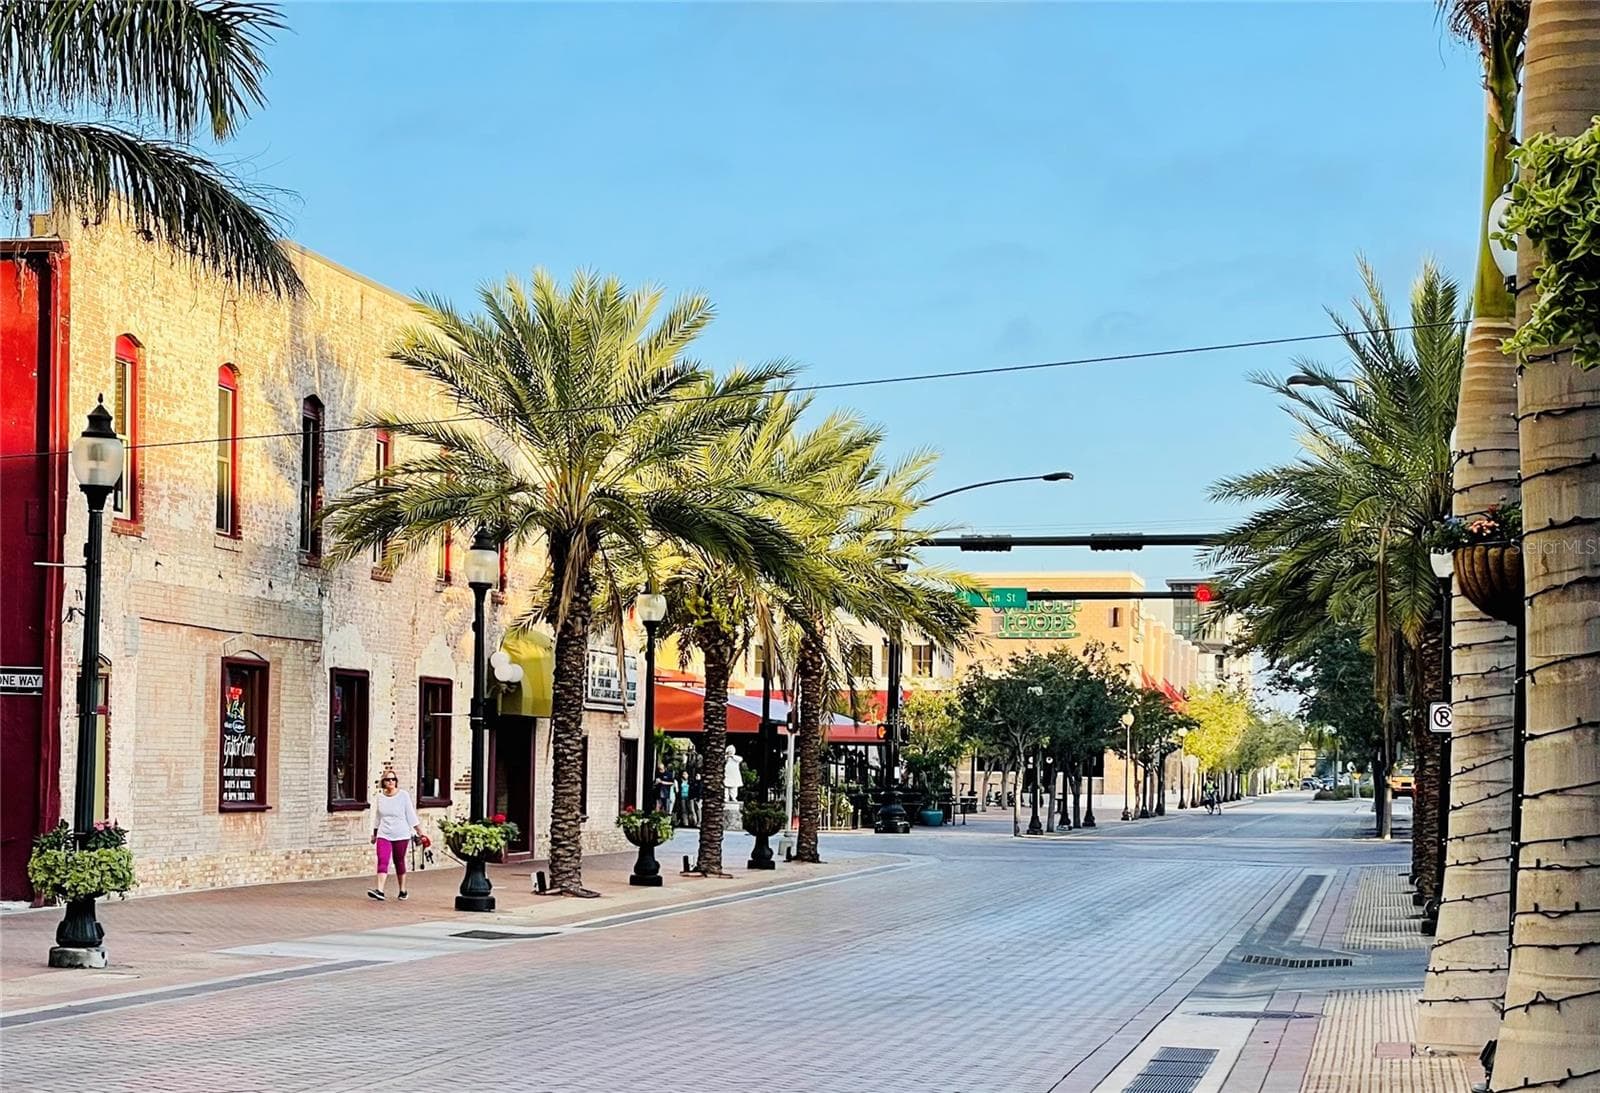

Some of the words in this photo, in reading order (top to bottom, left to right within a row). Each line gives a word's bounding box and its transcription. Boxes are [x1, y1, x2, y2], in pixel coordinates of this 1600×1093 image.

[1006, 593, 1016, 603] St
[1002, 614, 1077, 631] FOODS
[19, 675, 41, 686] WAY
